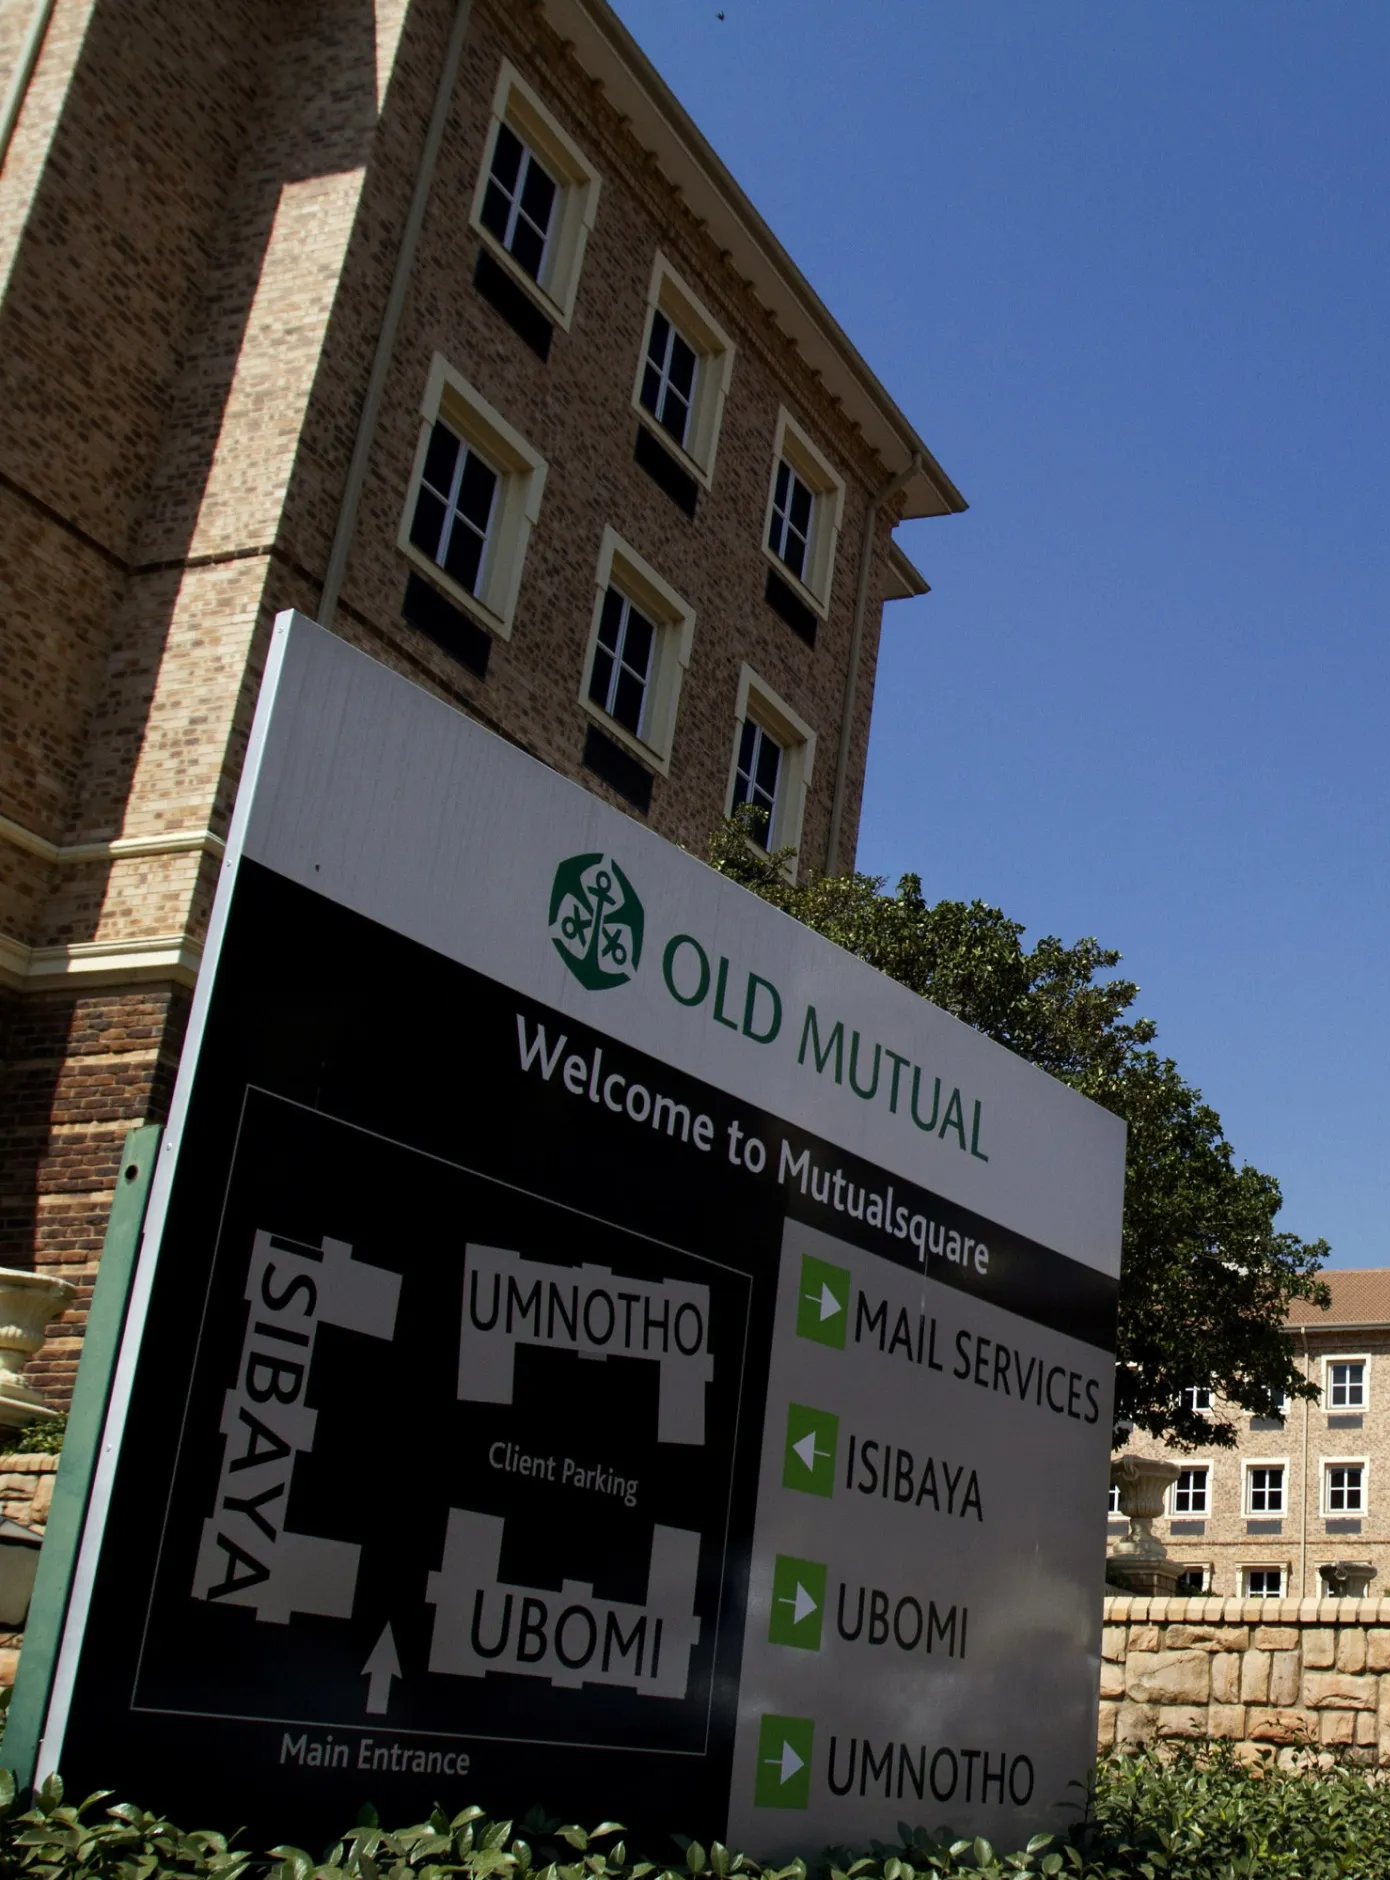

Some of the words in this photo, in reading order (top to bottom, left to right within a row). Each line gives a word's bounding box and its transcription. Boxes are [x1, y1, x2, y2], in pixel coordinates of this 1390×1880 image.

[662, 934, 783, 1044] OLD
[797, 1005, 989, 1163] MUTUAL
[516, 1014, 714, 1152] Welcome
[727, 1118, 767, 1173] to
[778, 1139, 990, 1276] Mutualsquare
[469, 1269, 702, 1357] UMNOTHO
[855, 1290, 944, 1372] MAIL
[953, 1330, 1101, 1425] SERVICES
[208, 1235, 323, 1602] ISIBAYA
[488, 1441, 555, 1482] Client
[562, 1459, 639, 1507] Parking
[846, 1435, 984, 1523] ISIBAYA
[471, 1589, 663, 1680] UBOMI
[837, 1583, 968, 1660] UBOMI
[280, 1732, 349, 1770] Main
[358, 1740, 471, 1776] Entrance
[827, 1736, 1035, 1807] UMNOTHO
